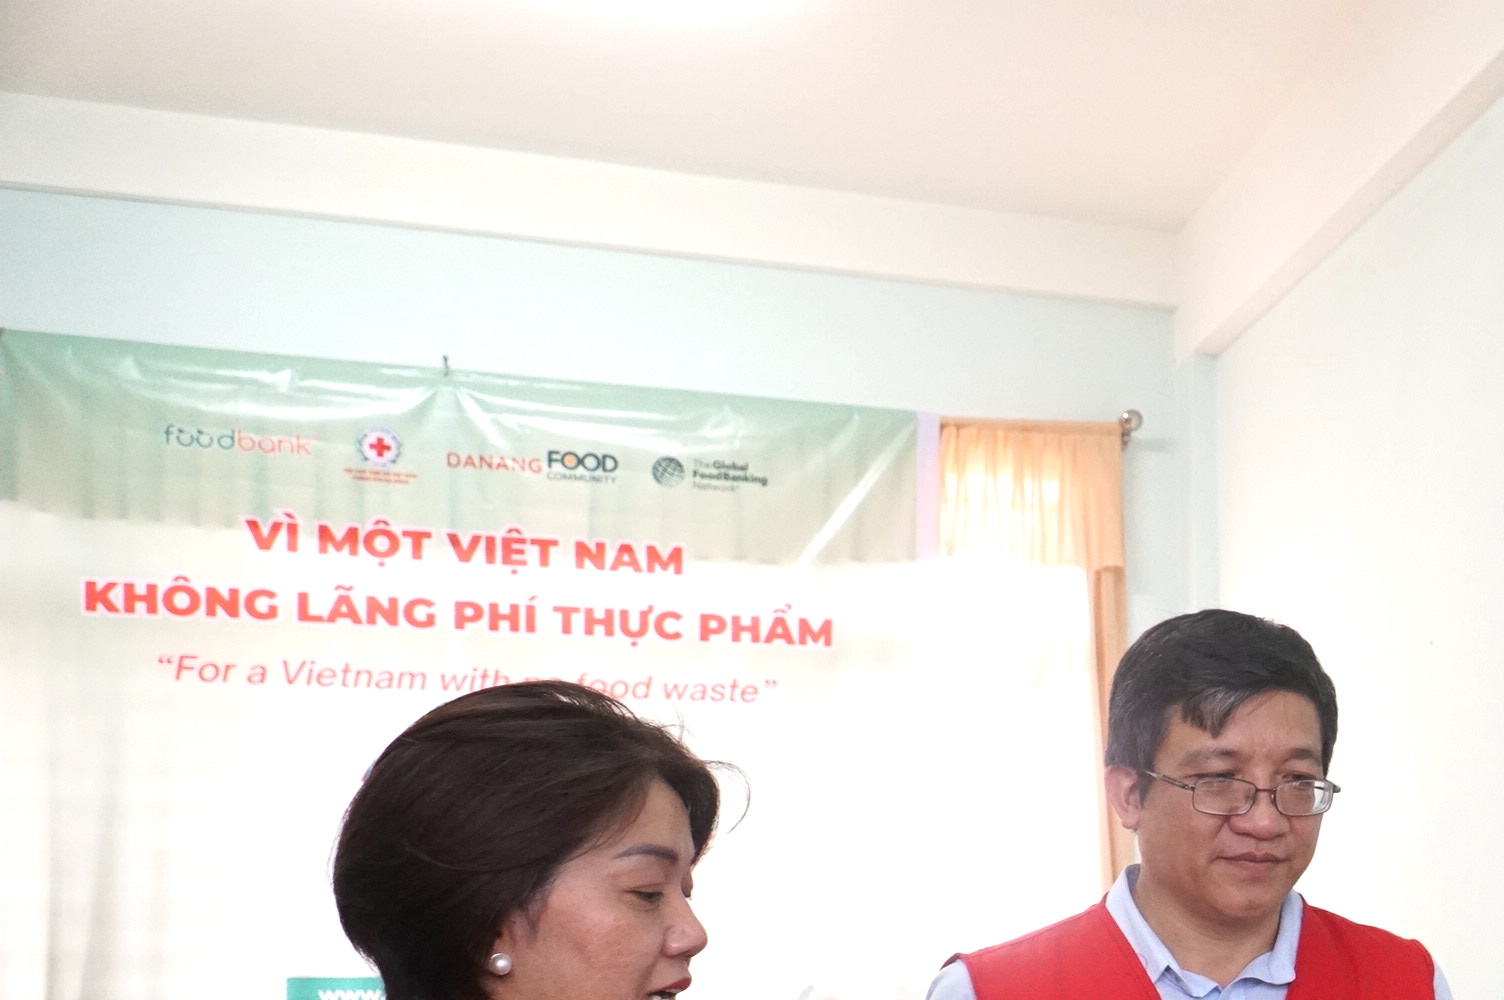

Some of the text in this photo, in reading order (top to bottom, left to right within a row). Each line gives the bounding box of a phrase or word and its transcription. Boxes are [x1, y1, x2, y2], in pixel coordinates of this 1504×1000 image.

[164, 424, 312, 457] foodbank
[446, 450, 619, 474] DANANG FOOD
[713, 458, 749, 471] Global
[547, 471, 617, 484] COMMUNITY
[692, 469, 768, 487] FoodBanking
[245, 512, 684, 575] VÌ MỘT VIỆT NAM
[84, 575, 834, 648] KHÔNG LÃNG PHÍ THỰC PHẨM
[246, 663, 268, 685] a
[283, 660, 427, 690] Vietnam
